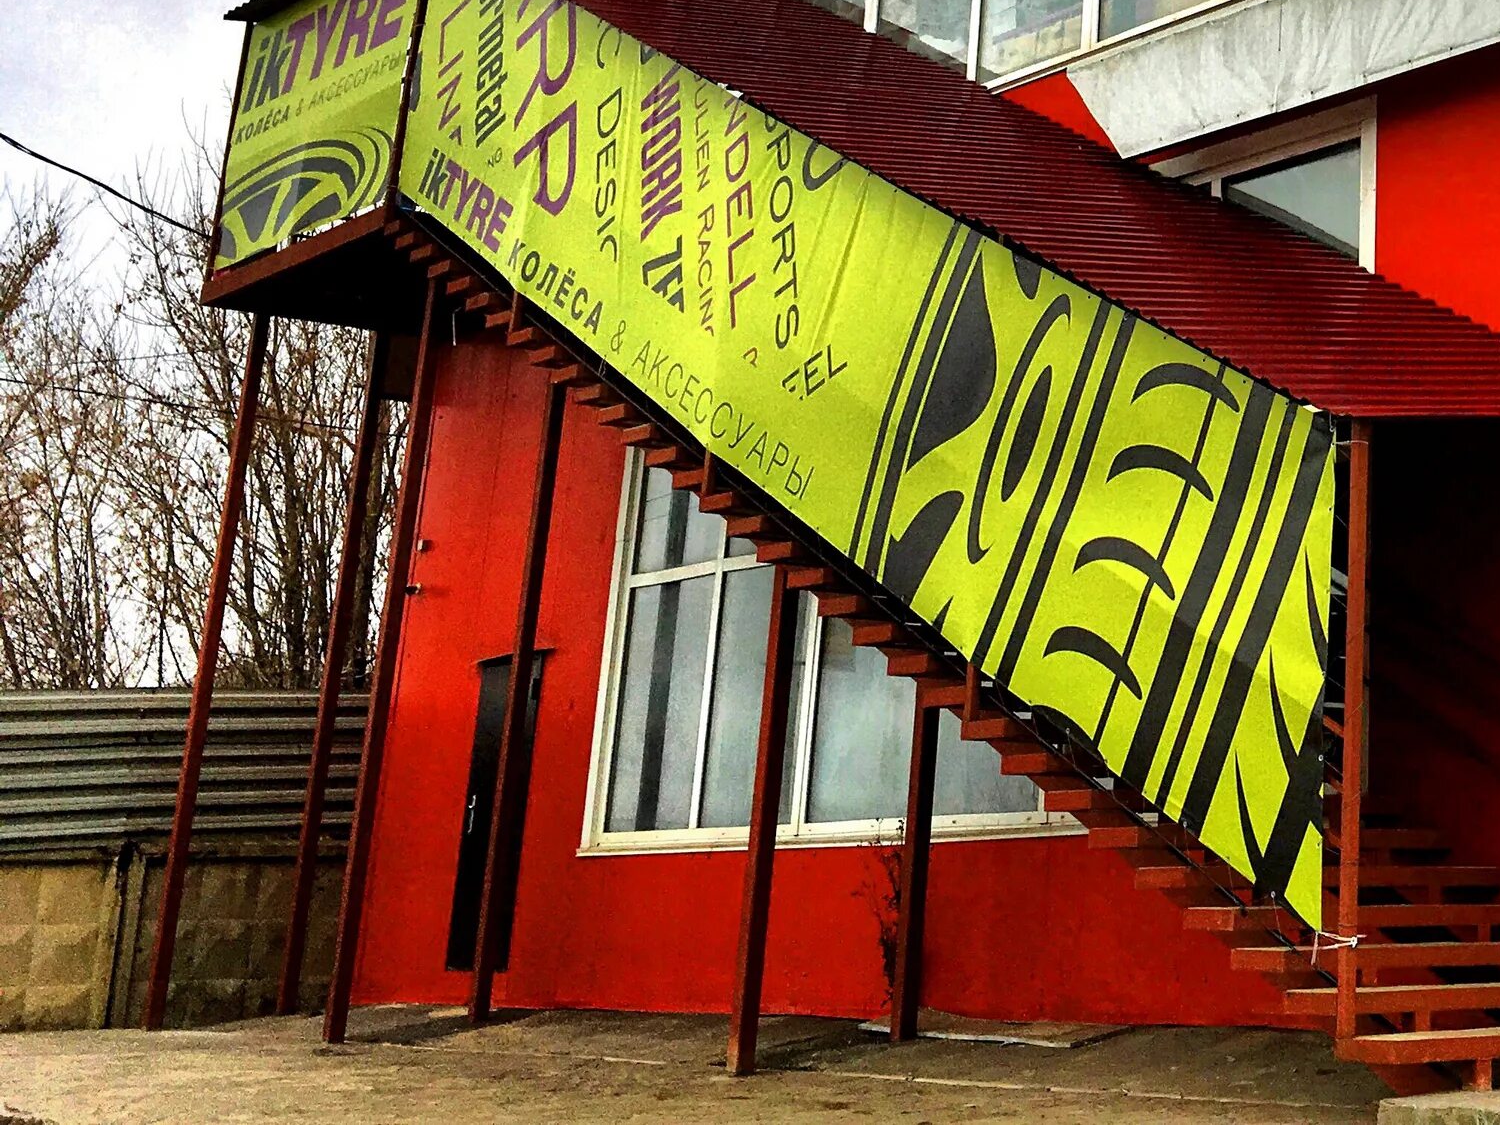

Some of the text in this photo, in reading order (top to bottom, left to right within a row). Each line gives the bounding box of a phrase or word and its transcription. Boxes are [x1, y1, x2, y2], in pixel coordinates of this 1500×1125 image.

[234, 104, 290, 146] КОЛЁСА
[640, 63, 683, 243] WORK
[418, 147, 514, 253] ikTYRE
[507, 237, 815, 501] КОЛЁСА & АКСЕССУАРЫ
